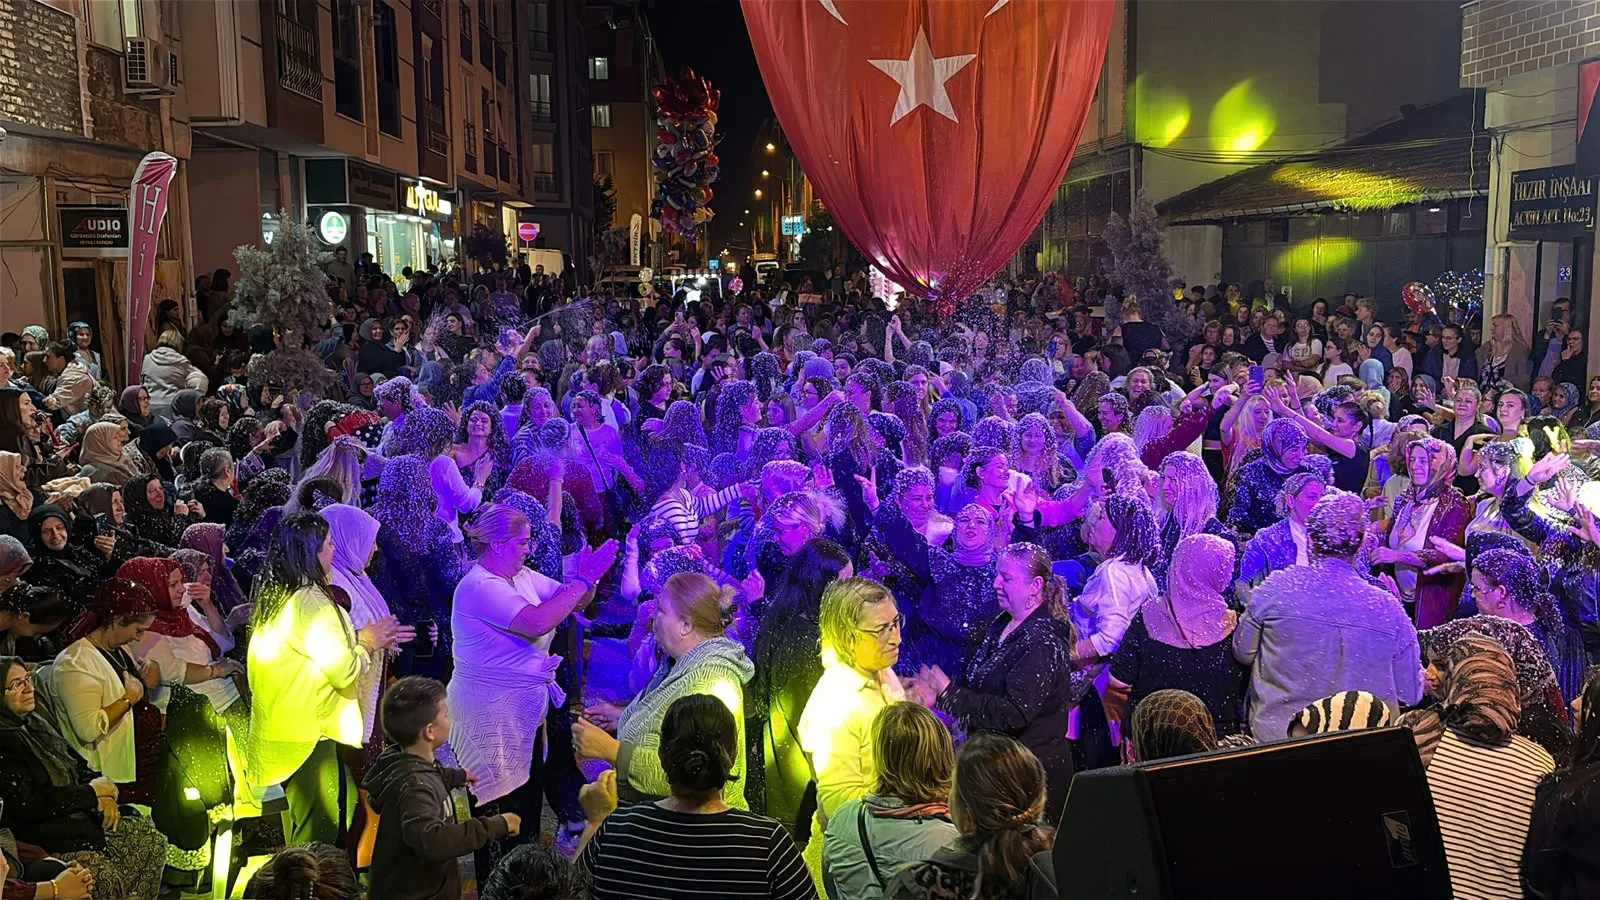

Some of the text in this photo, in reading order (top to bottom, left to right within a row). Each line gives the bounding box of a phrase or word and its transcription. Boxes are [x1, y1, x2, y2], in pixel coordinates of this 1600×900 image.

[1514, 180, 1547, 201] HIZIR
[1541, 208, 1561, 224] APT.
[1563, 206, 1591, 223] No:23
[1560, 267, 1571, 276] 23
